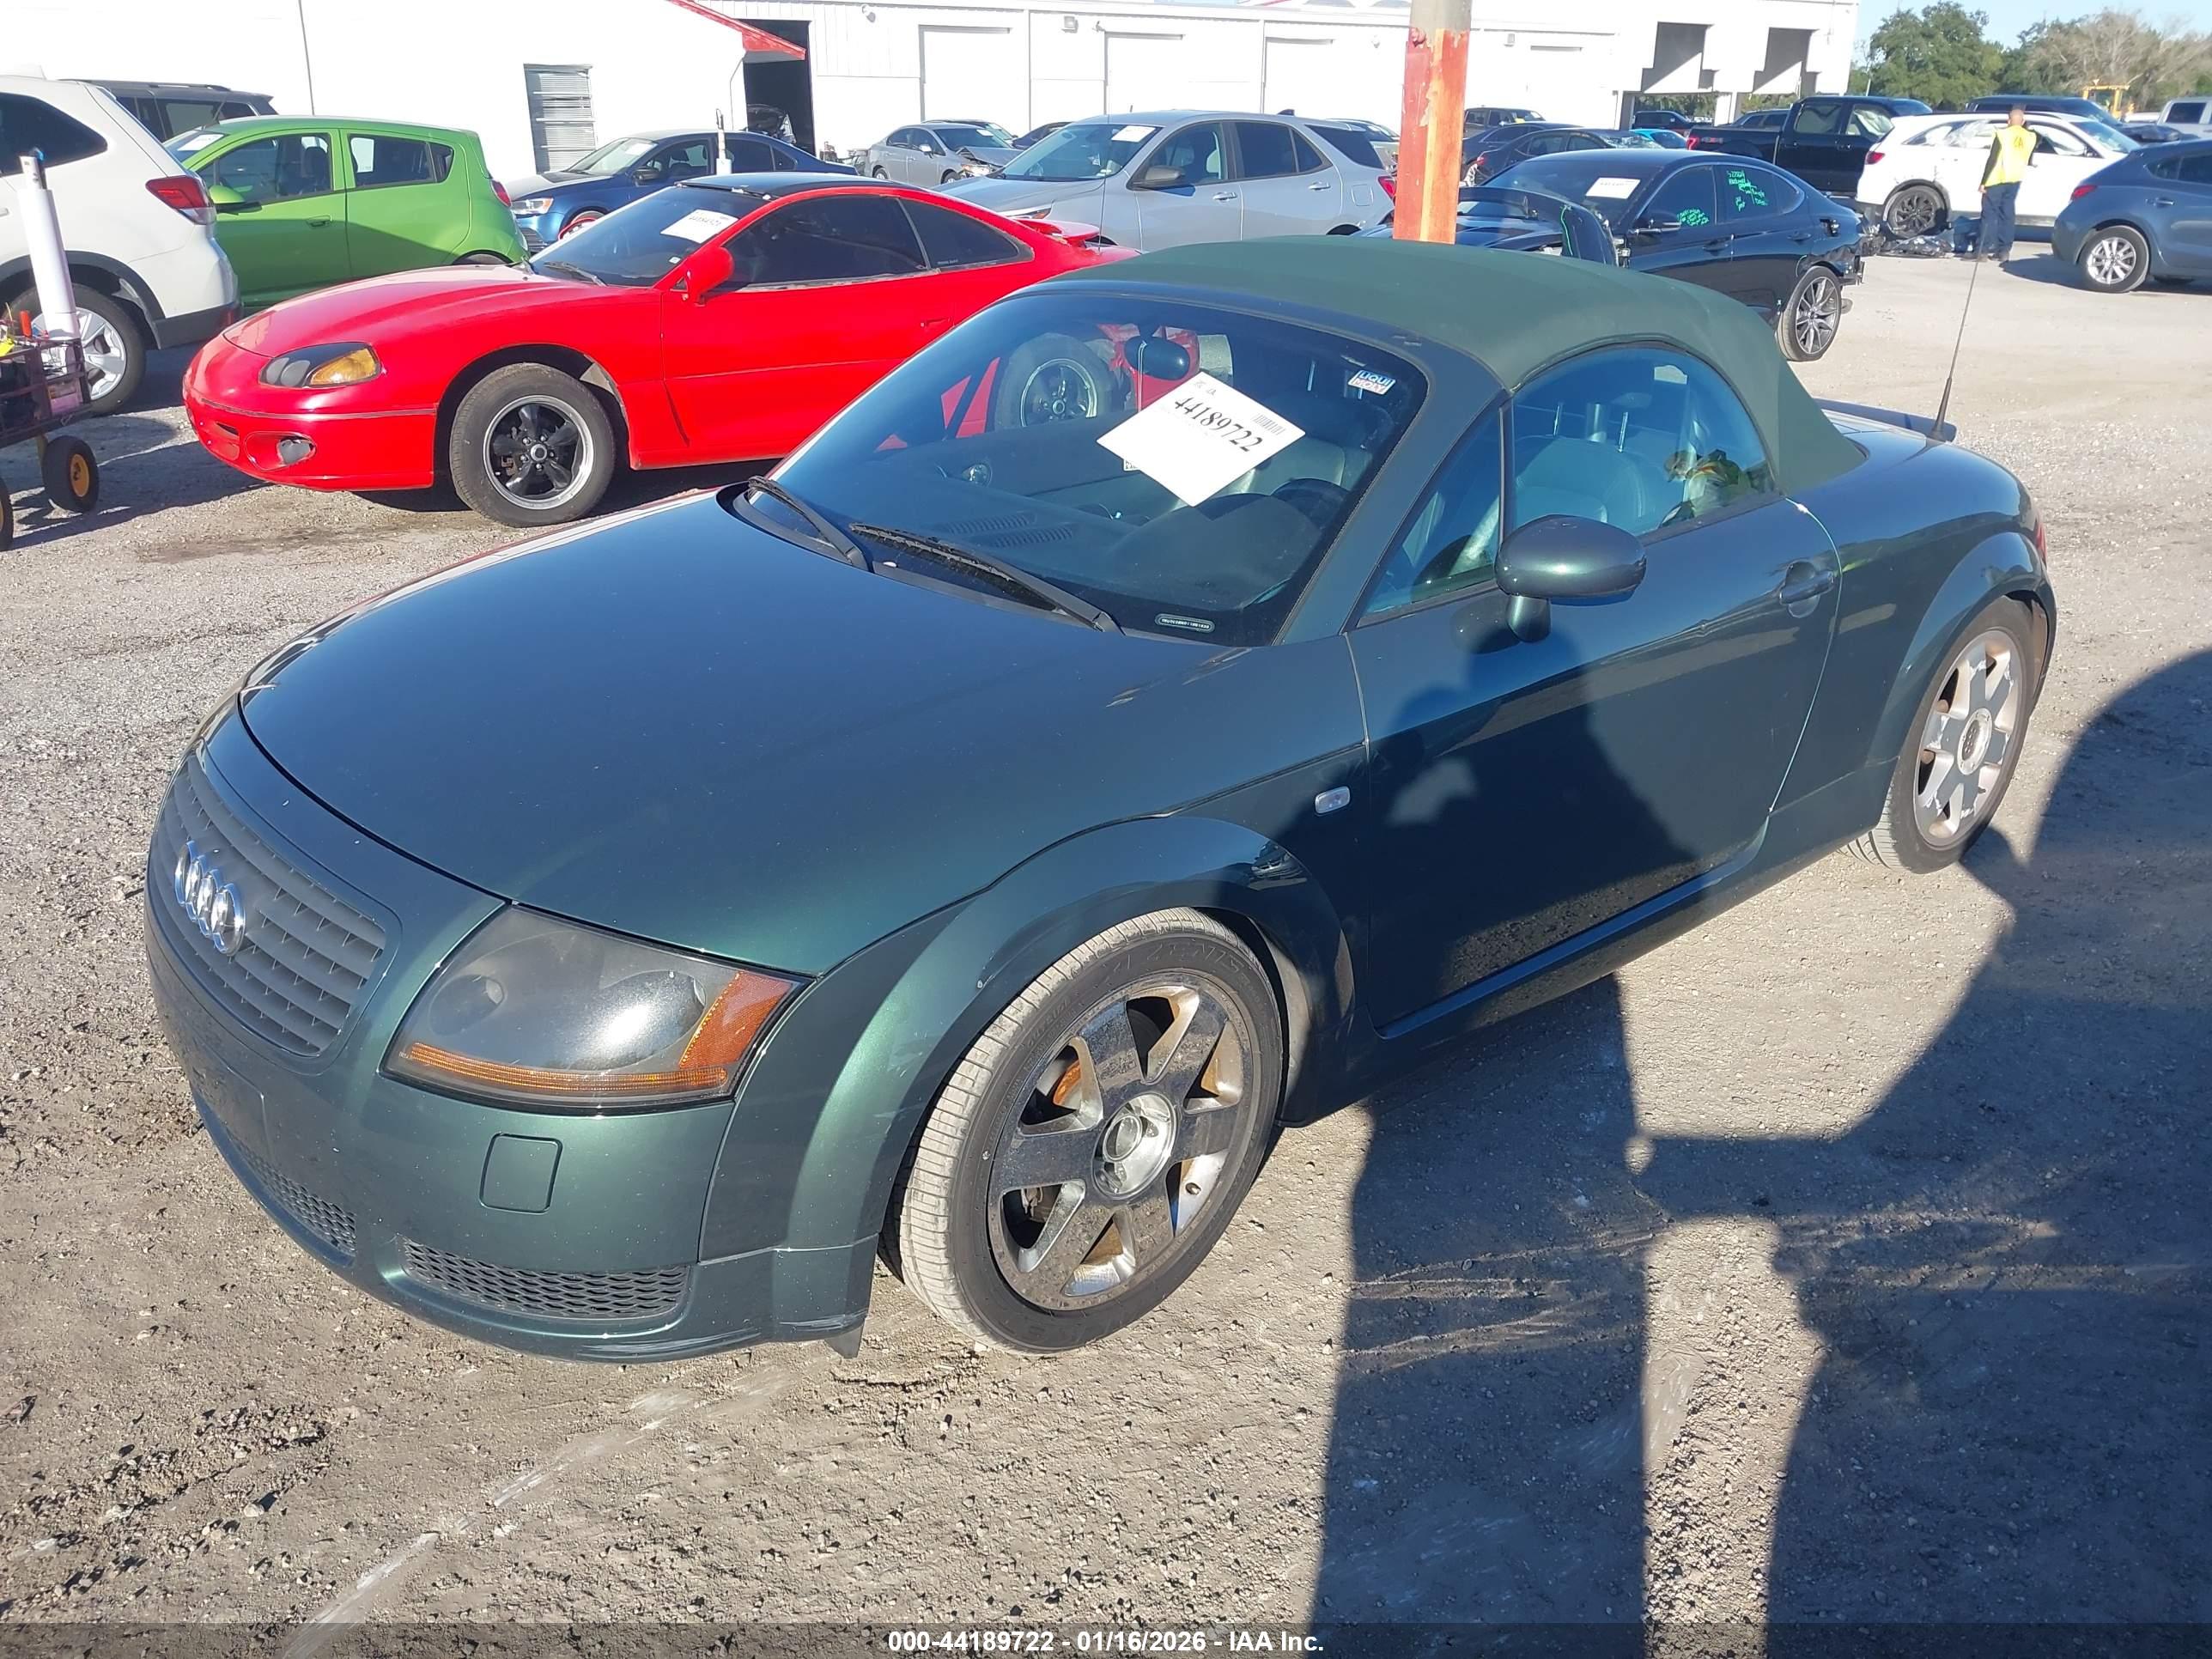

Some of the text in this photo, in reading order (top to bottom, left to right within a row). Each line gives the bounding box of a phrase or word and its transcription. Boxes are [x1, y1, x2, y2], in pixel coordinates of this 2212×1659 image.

[1352, 378, 1386, 393] MOLY
[1358, 370, 1392, 386] LIQUI
[1174, 396, 1263, 453] 44189722
